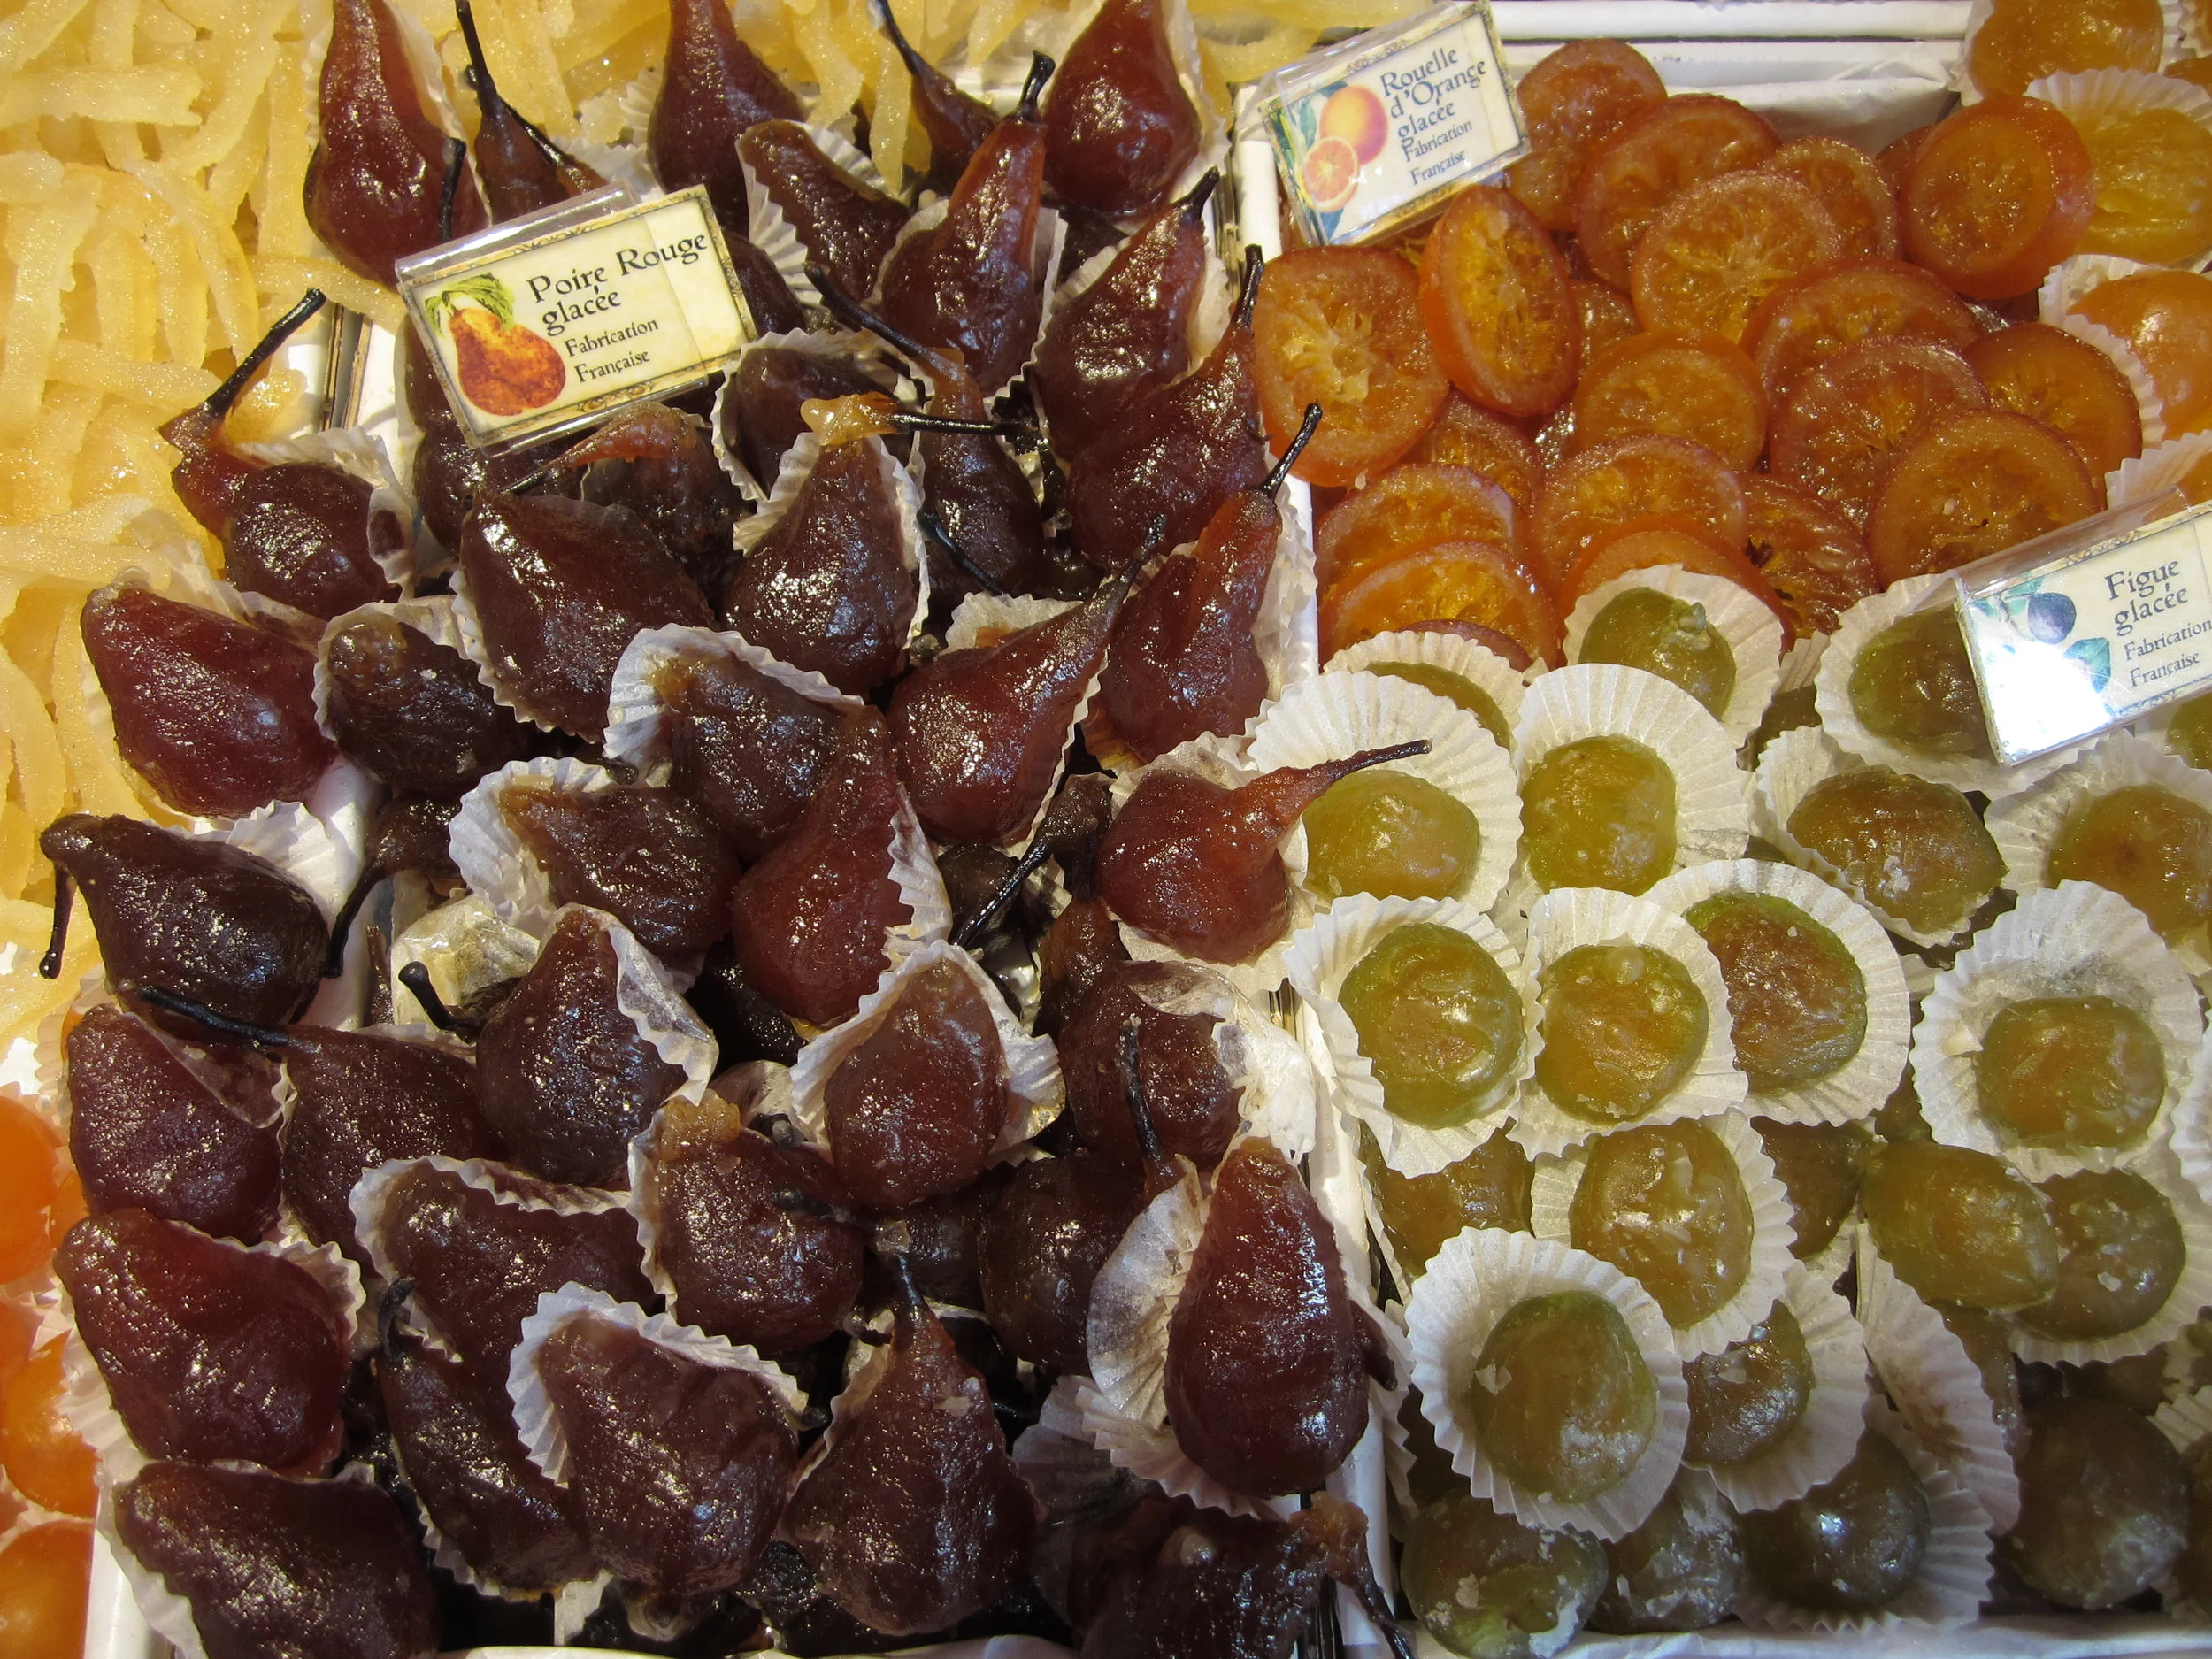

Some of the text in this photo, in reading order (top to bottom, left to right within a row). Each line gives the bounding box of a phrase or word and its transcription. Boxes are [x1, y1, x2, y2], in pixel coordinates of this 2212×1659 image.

[1380, 47, 1458, 97] Rouelle
[1390, 59, 1486, 119] d'Orange
[1397, 98, 1455, 147] glacée
[1402, 119, 1472, 162] Fabrication
[1409, 150, 1465, 186] Française
[526, 234, 708, 303] Poire Rouge
[541, 286, 621, 336] glacée
[563, 317, 659, 357] Fabrication
[573, 349, 650, 383] Française
[2104, 560, 2180, 601] Figue
[2114, 582, 2188, 637] glacée
[2124, 619, 2212, 661] Fabrication
[2129, 650, 2200, 687] Française
